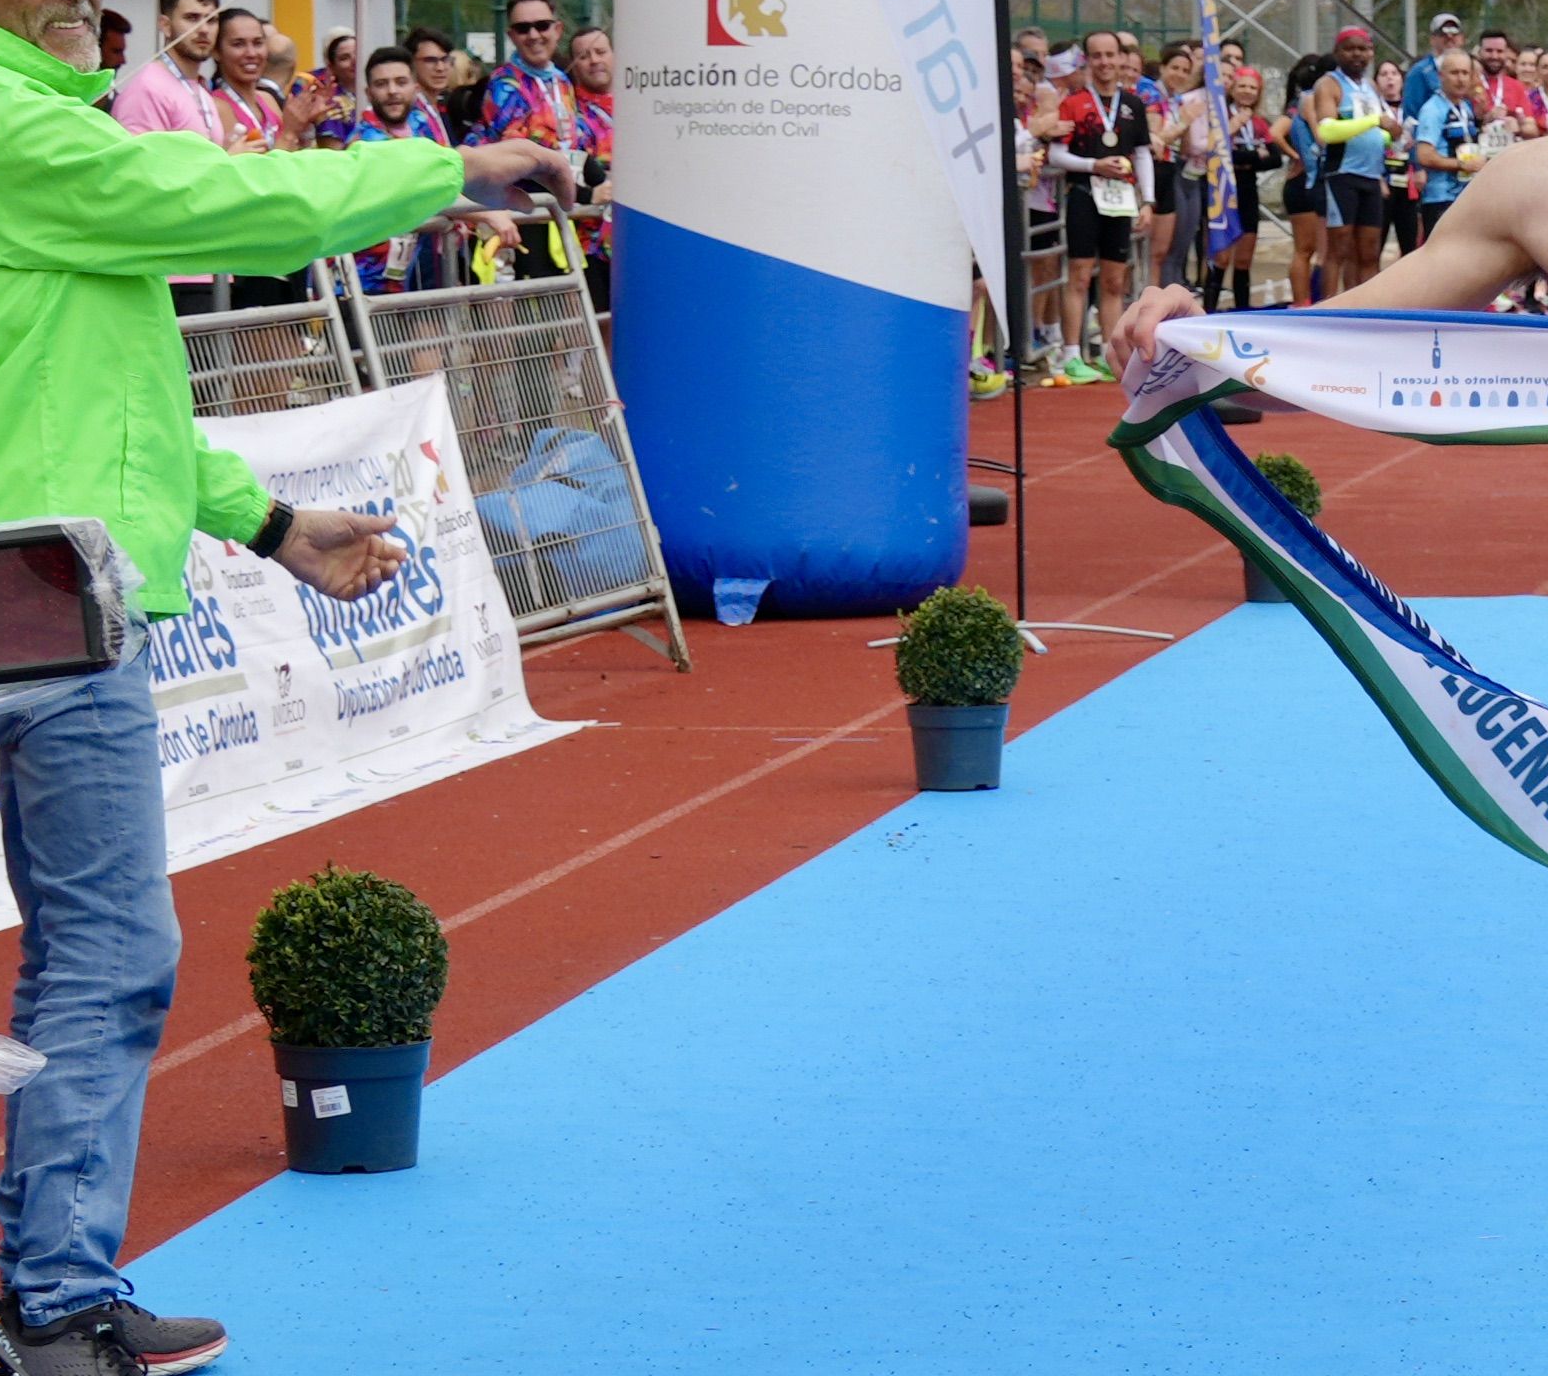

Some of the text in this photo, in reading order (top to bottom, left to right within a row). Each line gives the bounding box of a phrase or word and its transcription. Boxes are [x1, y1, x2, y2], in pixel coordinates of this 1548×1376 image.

[624, 63, 903, 93] Diputación de Córdoba
[653, 99, 852, 118] Delegación de Deportes
[675, 121, 820, 140] y Protección Civil
[184, 714, 211, 757] de
